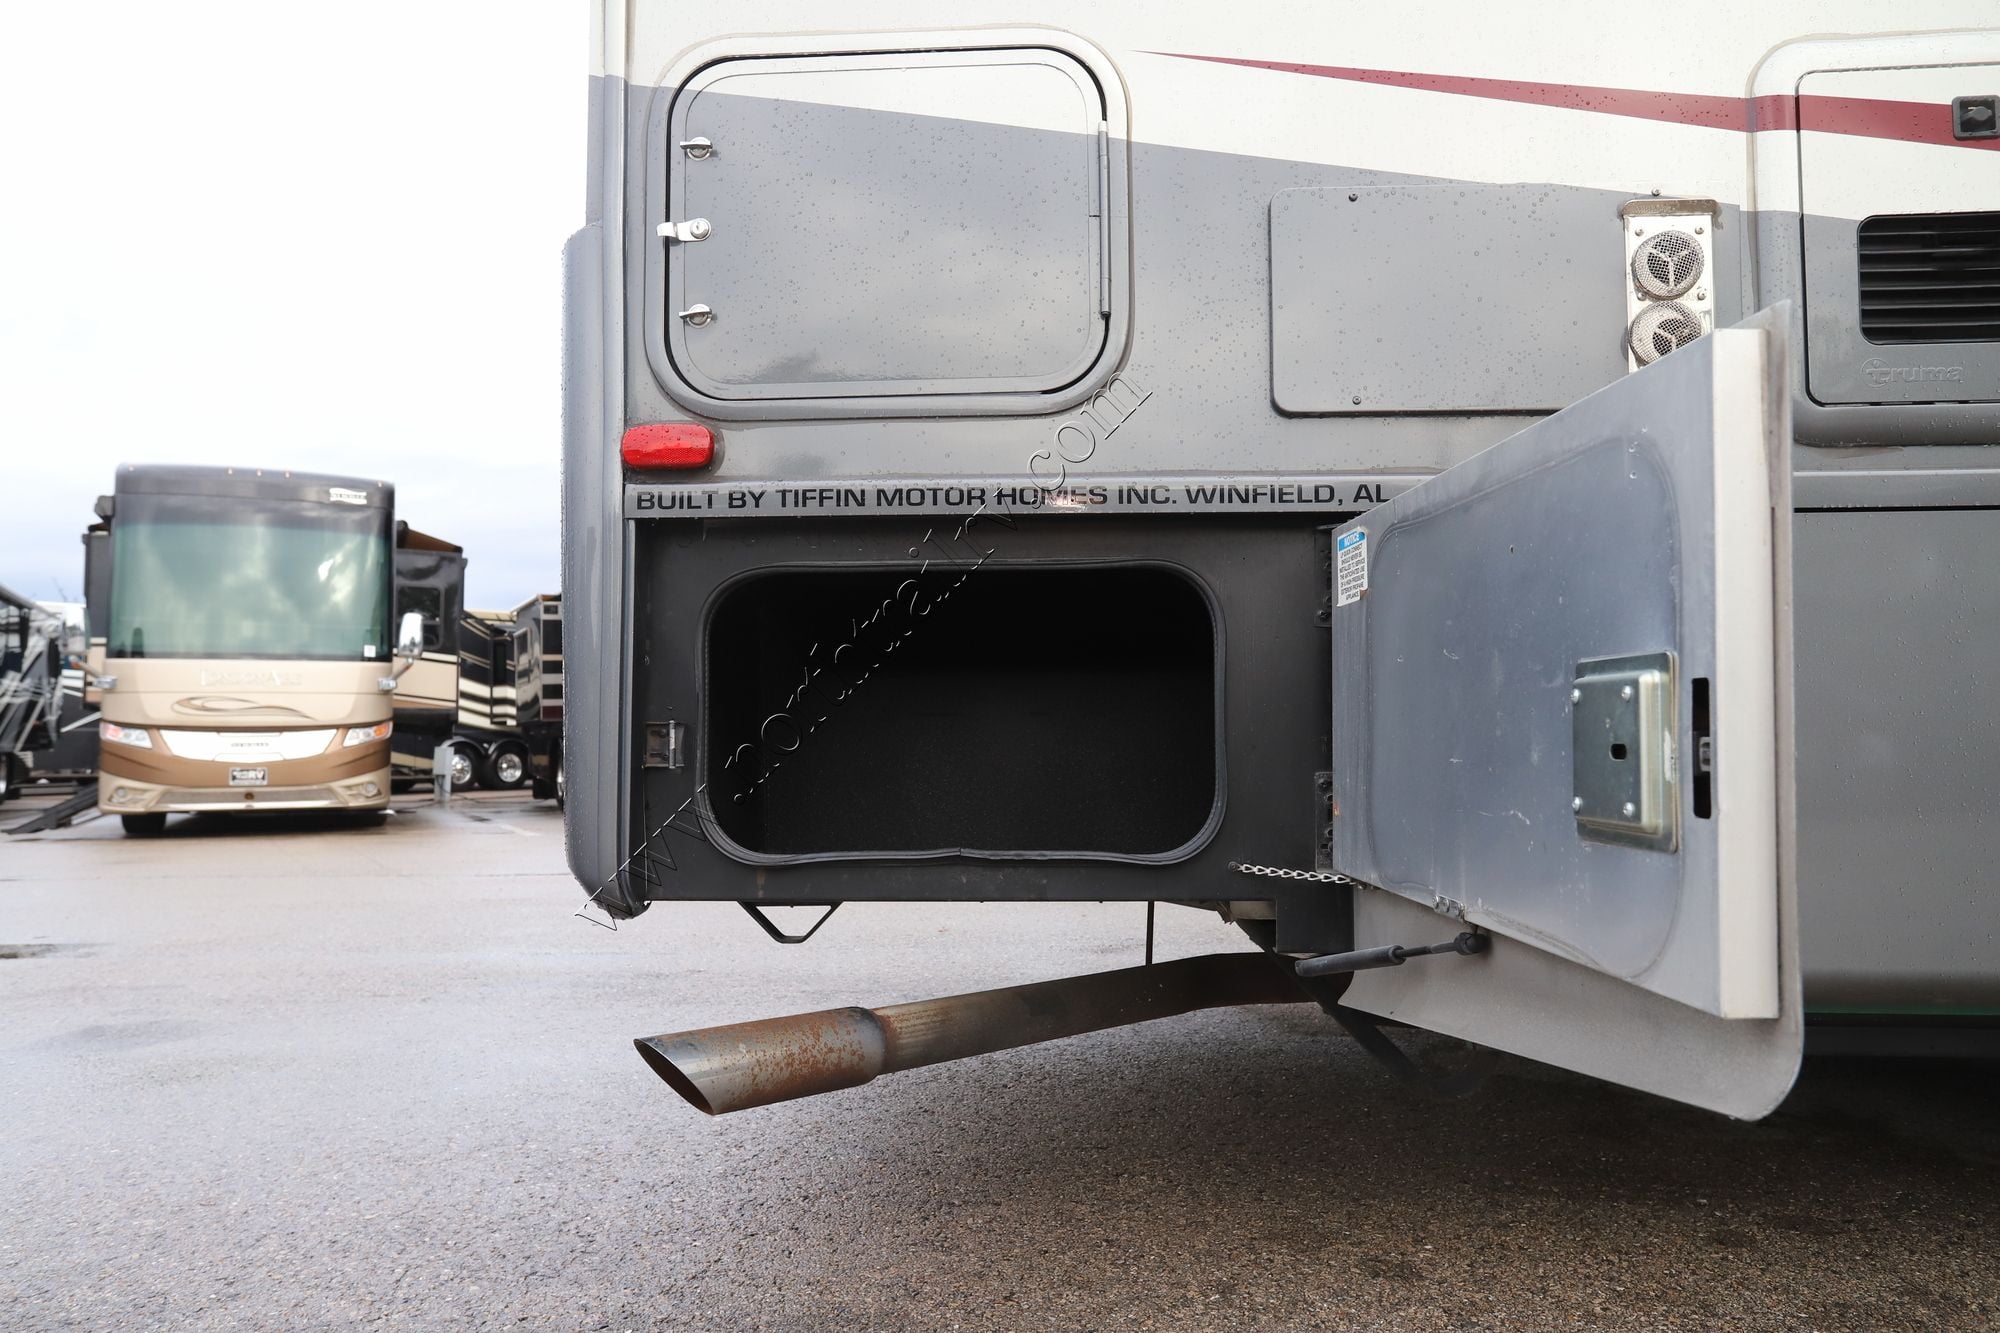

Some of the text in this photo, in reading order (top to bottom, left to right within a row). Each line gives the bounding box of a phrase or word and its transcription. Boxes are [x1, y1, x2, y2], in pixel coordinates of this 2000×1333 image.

[1862, 358, 1963, 387] truma
[637, 483, 1391, 510] BUILT BY TIFFIN MOTOR HOMES INC. WINFIELD, AL
